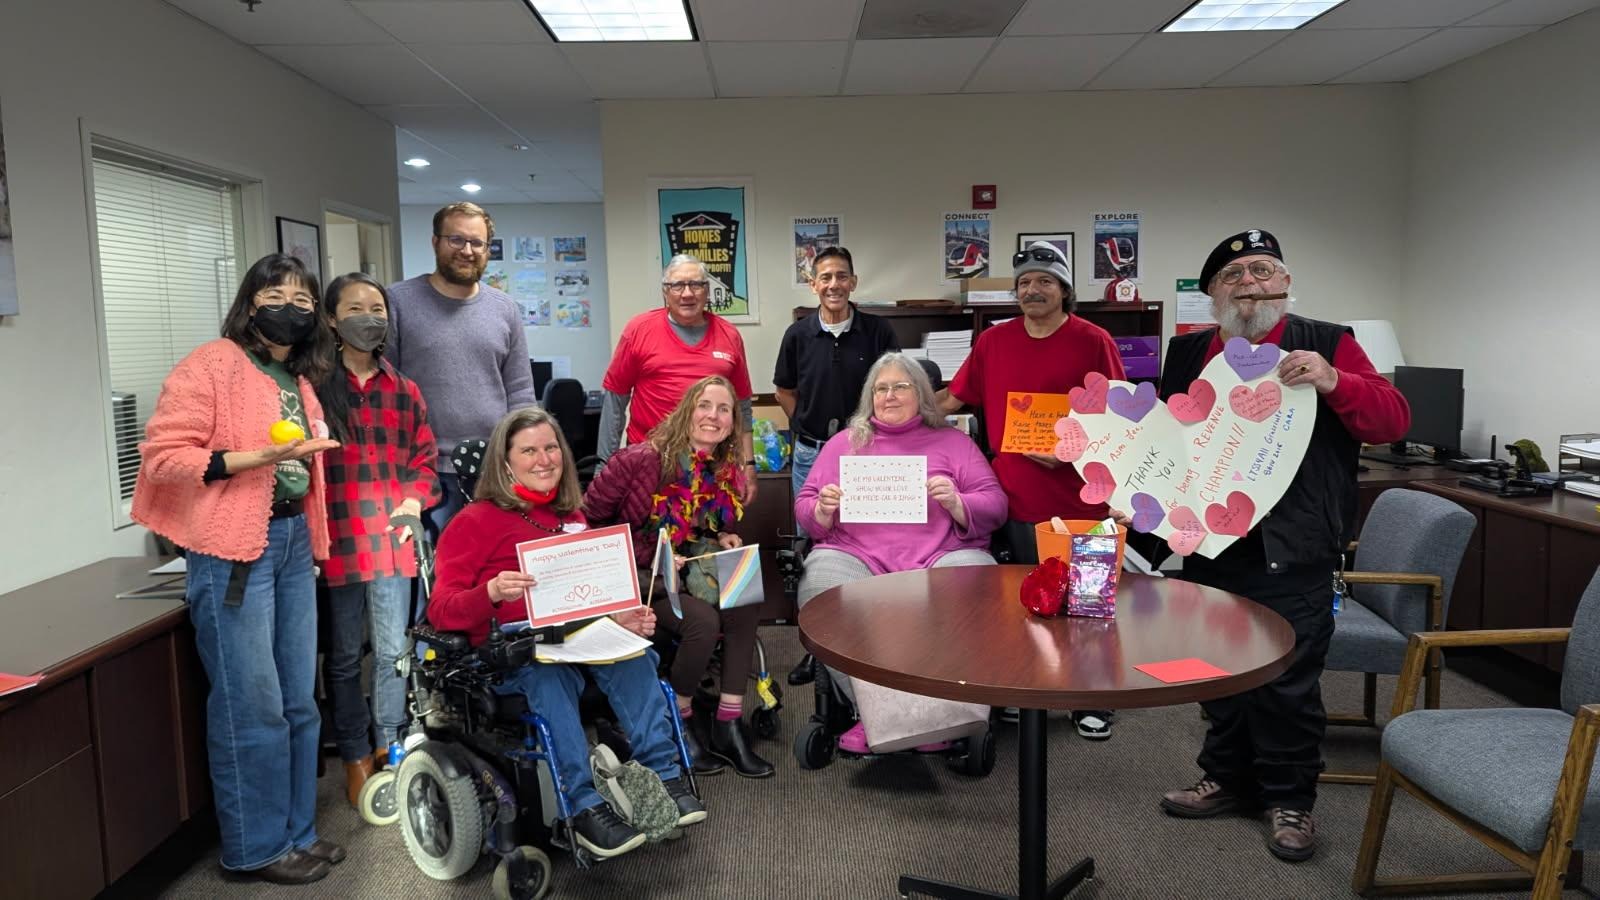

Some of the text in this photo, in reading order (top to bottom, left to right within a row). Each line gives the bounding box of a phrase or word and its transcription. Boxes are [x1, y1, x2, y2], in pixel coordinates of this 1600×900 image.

[684, 229, 721, 243] HOMES
[1087, 432, 1112, 453] Dear
[1176, 468, 1201, 494] being
[1193, 405, 1225, 449] REVENUE
[1124, 446, 1160, 491] THANK
